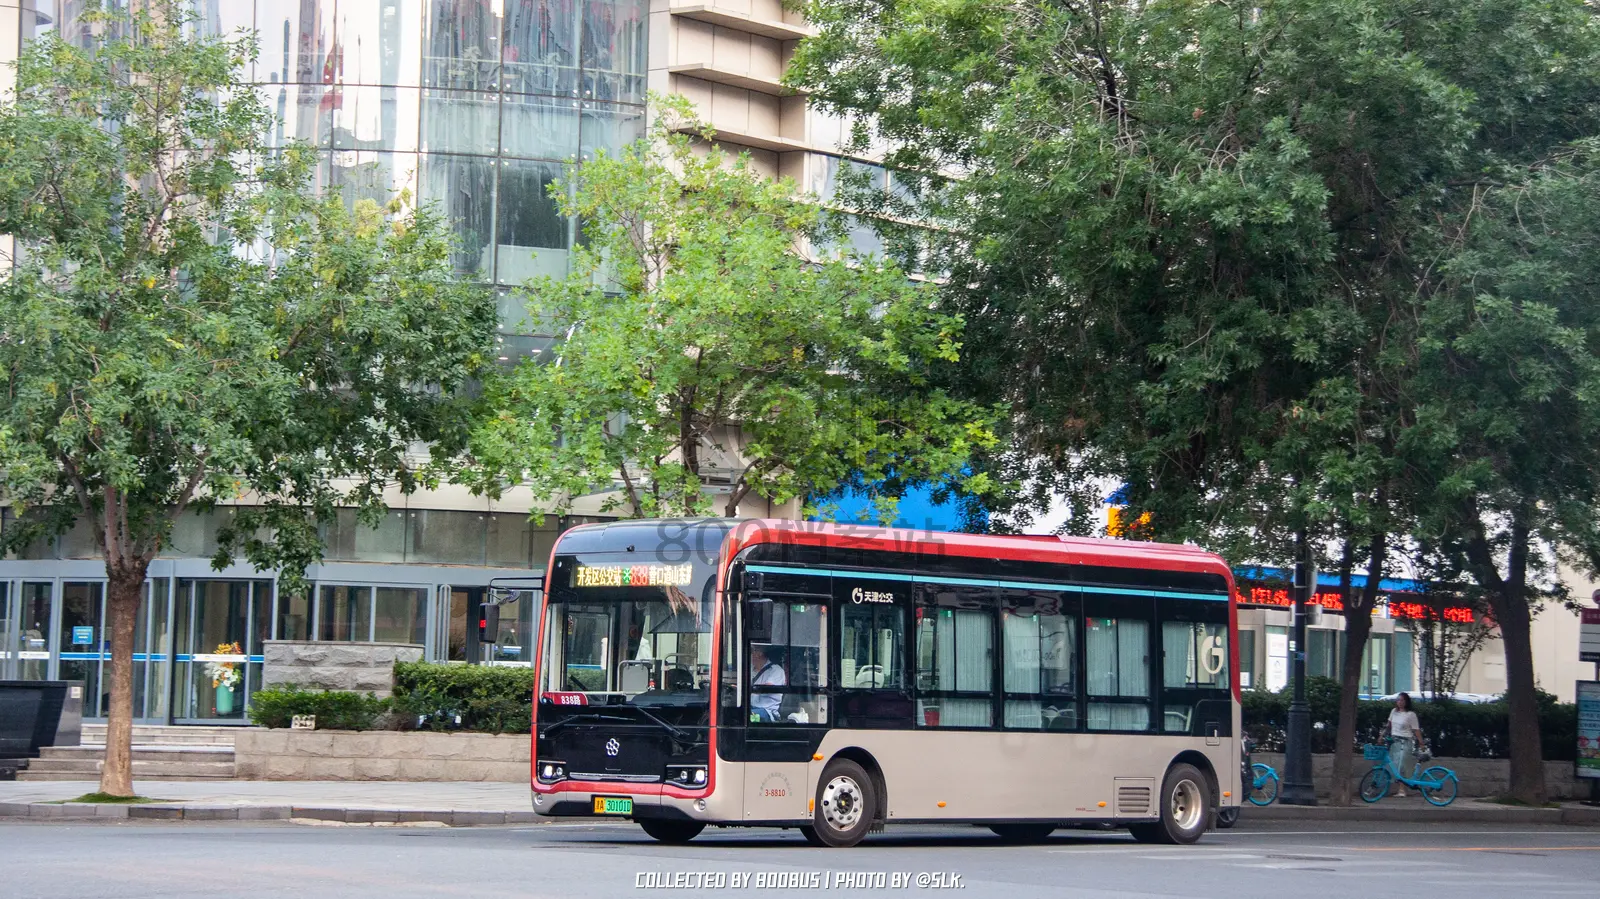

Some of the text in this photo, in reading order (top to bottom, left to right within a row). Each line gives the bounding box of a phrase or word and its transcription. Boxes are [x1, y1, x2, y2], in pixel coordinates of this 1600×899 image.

[631, 565, 648, 586] 838
[864, 591, 894, 604] 天津公交
[561, 695, 581, 706] 838路
[765, 789, 786, 797] 3-8810
